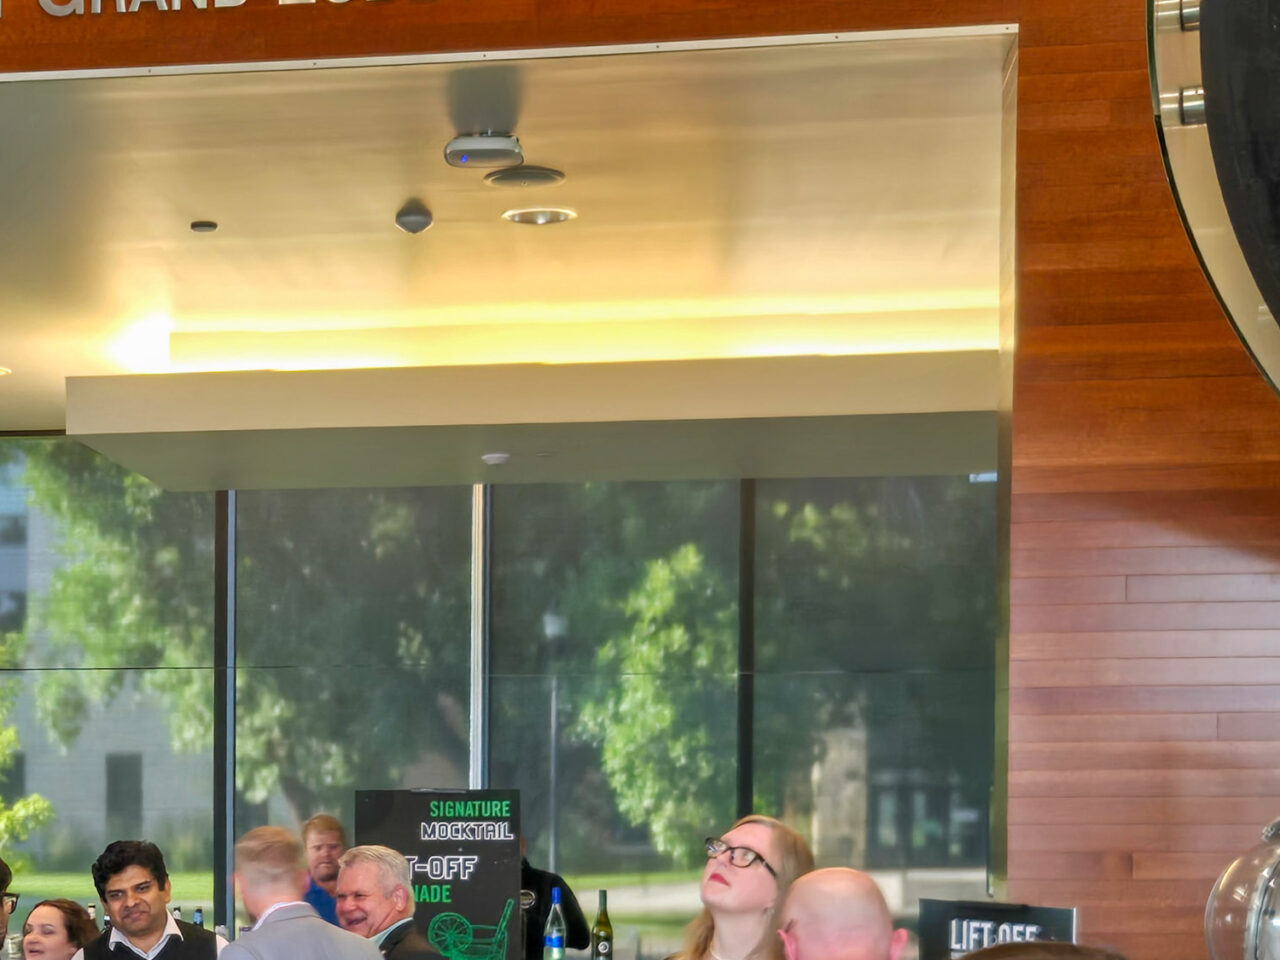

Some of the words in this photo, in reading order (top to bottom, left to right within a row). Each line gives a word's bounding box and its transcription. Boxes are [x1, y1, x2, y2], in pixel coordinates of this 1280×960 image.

[430, 801, 511, 817] SIGNATURE
[421, 822, 514, 840] MOCKTAIL
[951, 918, 992, 950] LIFT
